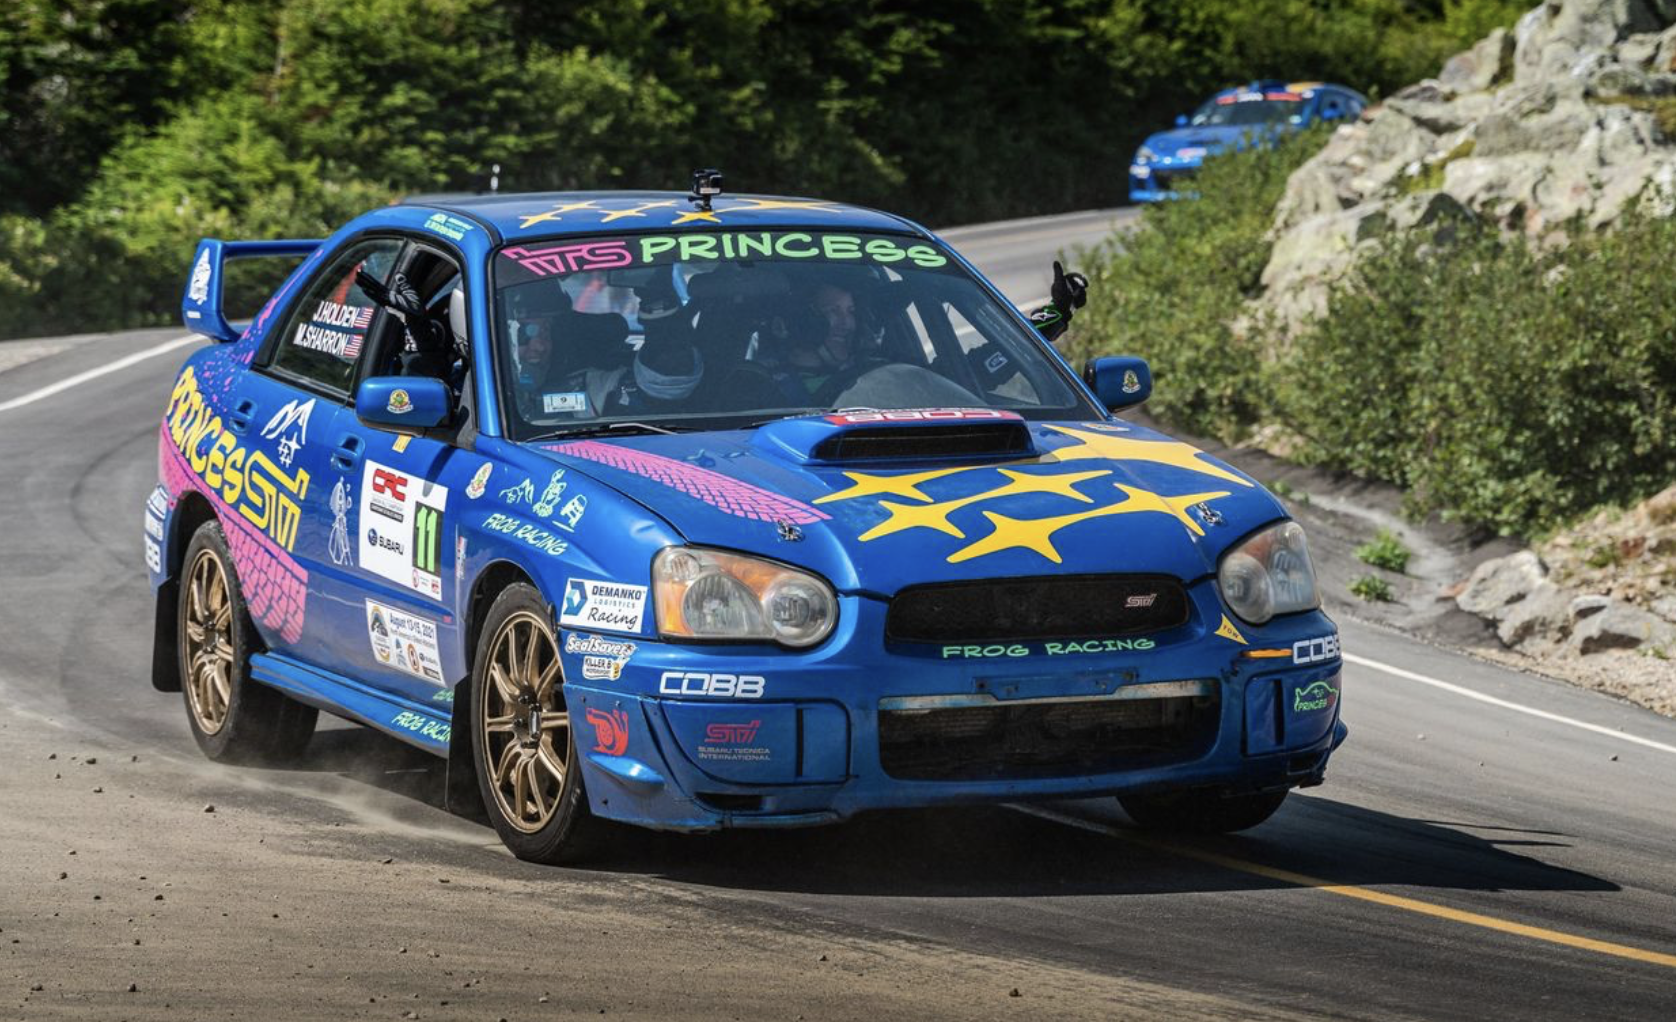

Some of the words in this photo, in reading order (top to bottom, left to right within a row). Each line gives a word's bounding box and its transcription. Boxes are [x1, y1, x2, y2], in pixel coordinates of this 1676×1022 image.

[640, 232, 948, 267] PRINCESS
[379, 535, 405, 556] SUBARU
[416, 505, 438, 574] 11
[482, 513, 520, 533] FROG
[513, 524, 568, 556] RACING
[591, 585, 643, 600] DEMANKO
[594, 598, 636, 609] LOGISTICS
[587, 606, 639, 630] Racing
[942, 644, 1030, 658] FROG
[1045, 638, 1156, 656] RACING
[659, 671, 765, 698] COBB
[391, 711, 426, 731] FROG
[420, 720, 451, 743] RACIN
[698, 746, 732, 754] SUBARU
[698, 753, 771, 761] INTERNATIONAL
